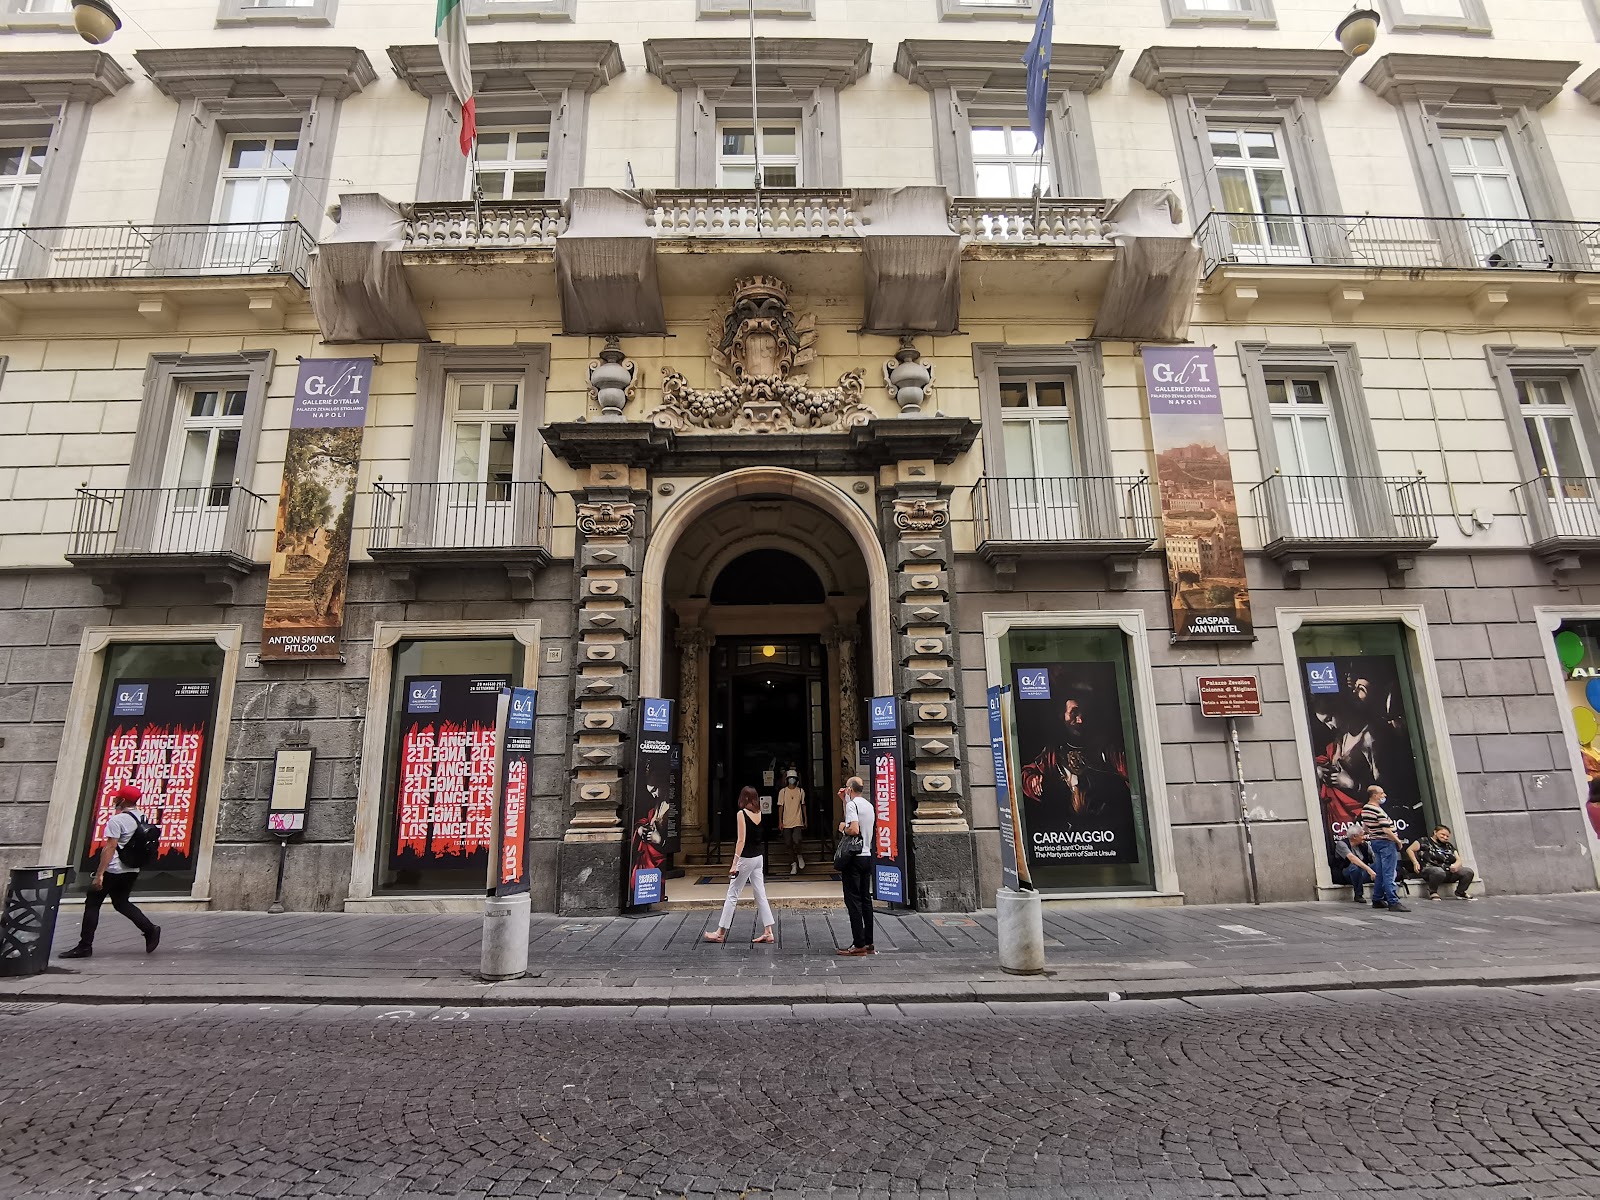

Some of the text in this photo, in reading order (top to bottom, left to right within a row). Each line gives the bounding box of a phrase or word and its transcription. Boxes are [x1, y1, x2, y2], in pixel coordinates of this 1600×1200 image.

[268, 635, 335, 644] ANTON SMINCK
[1572, 667, 1600, 677] AL
[111, 734, 199, 750] LOS ANGELES
[408, 732, 435, 747] LOS
[438, 731, 496, 747] ANGELES
[105, 764, 195, 780] LOS ANGELES
[405, 761, 495, 778] LOS ANGELES
[403, 791, 493, 808] LOS ANGELES
[506, 761, 522, 837] ANGELES
[876, 756, 891, 857] LOS ANGELES
[401, 822, 492, 839] LOS ANGELES
[1033, 830, 1114, 844] CARAVAGGIO
[506, 844, 516, 880] LOS
